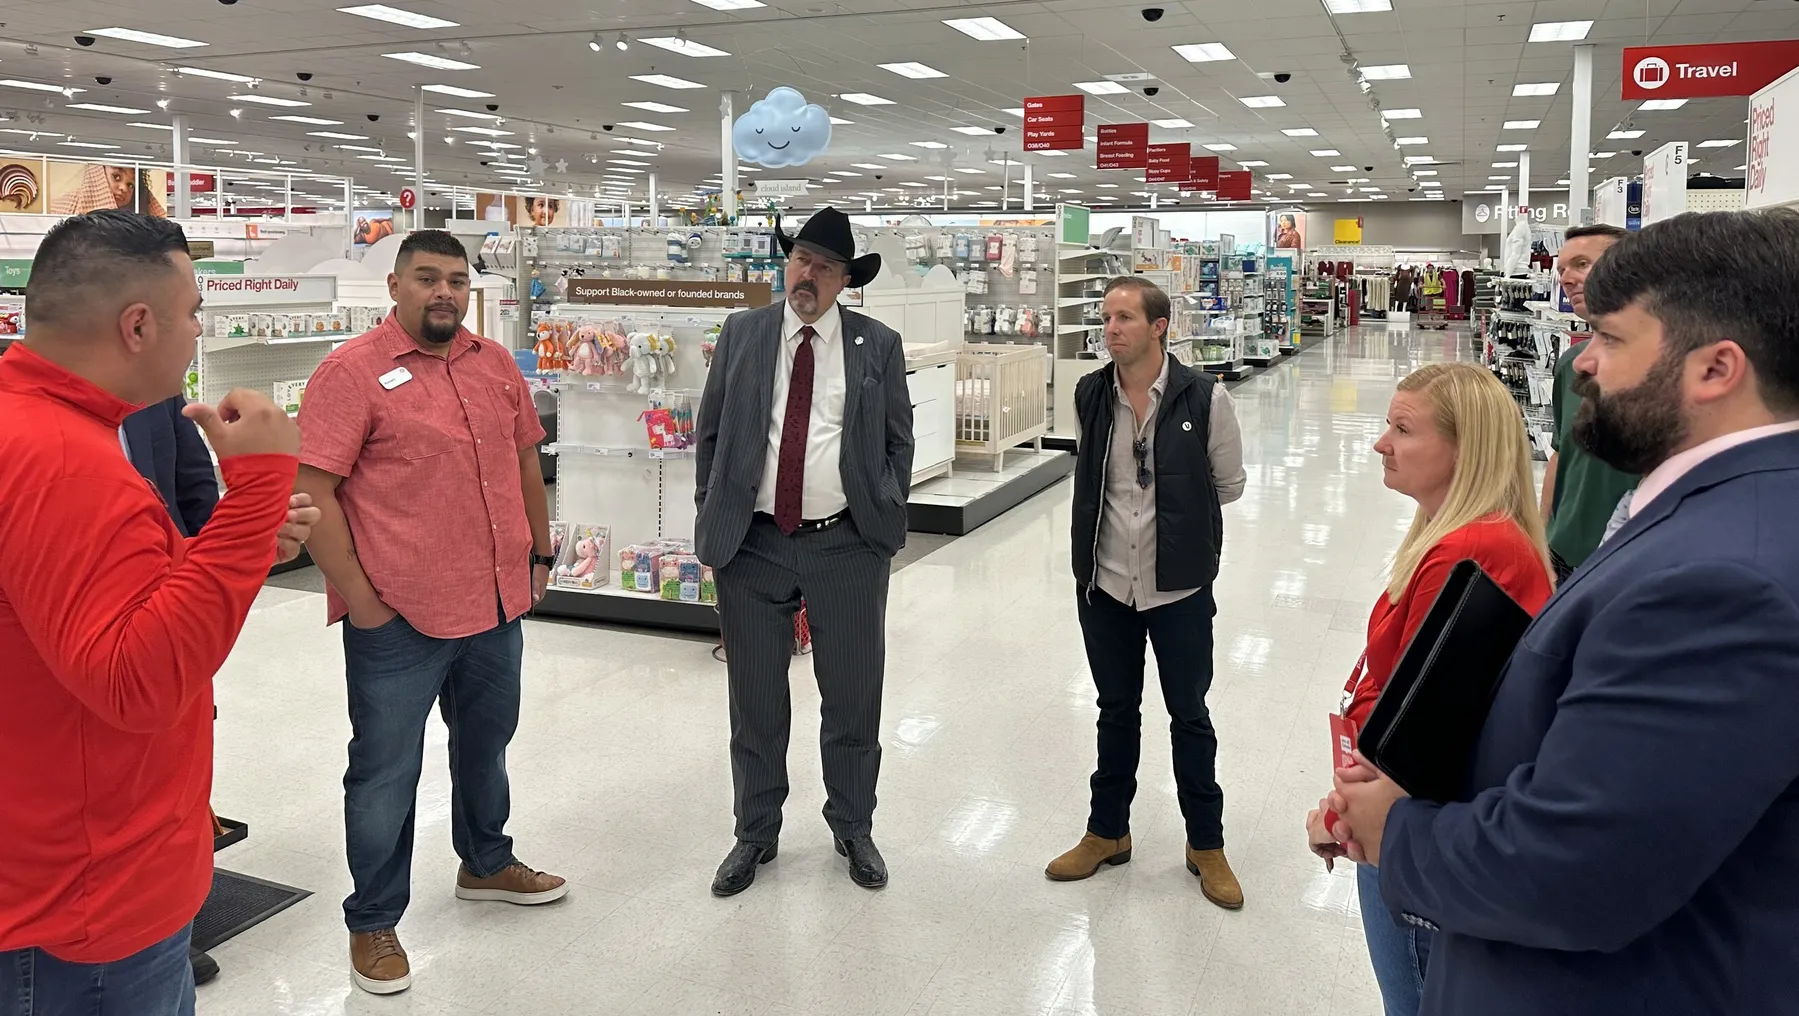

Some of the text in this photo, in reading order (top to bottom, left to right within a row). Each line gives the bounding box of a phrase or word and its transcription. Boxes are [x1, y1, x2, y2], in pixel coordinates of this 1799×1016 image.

[1676, 61, 1737, 78] Travel
[1752, 97, 1775, 134] Priced
[1750, 131, 1770, 162] Right
[1748, 161, 1767, 194] Daily
[760, 184, 801, 192] cloud island
[5, 266, 20, 276] Toys
[206, 279, 299, 293] Priced Right Daily
[575, 287, 610, 297] Support
[611, 288, 665, 297] Black-owned
[677, 289, 713, 299] founded
[714, 290, 745, 299] brands
